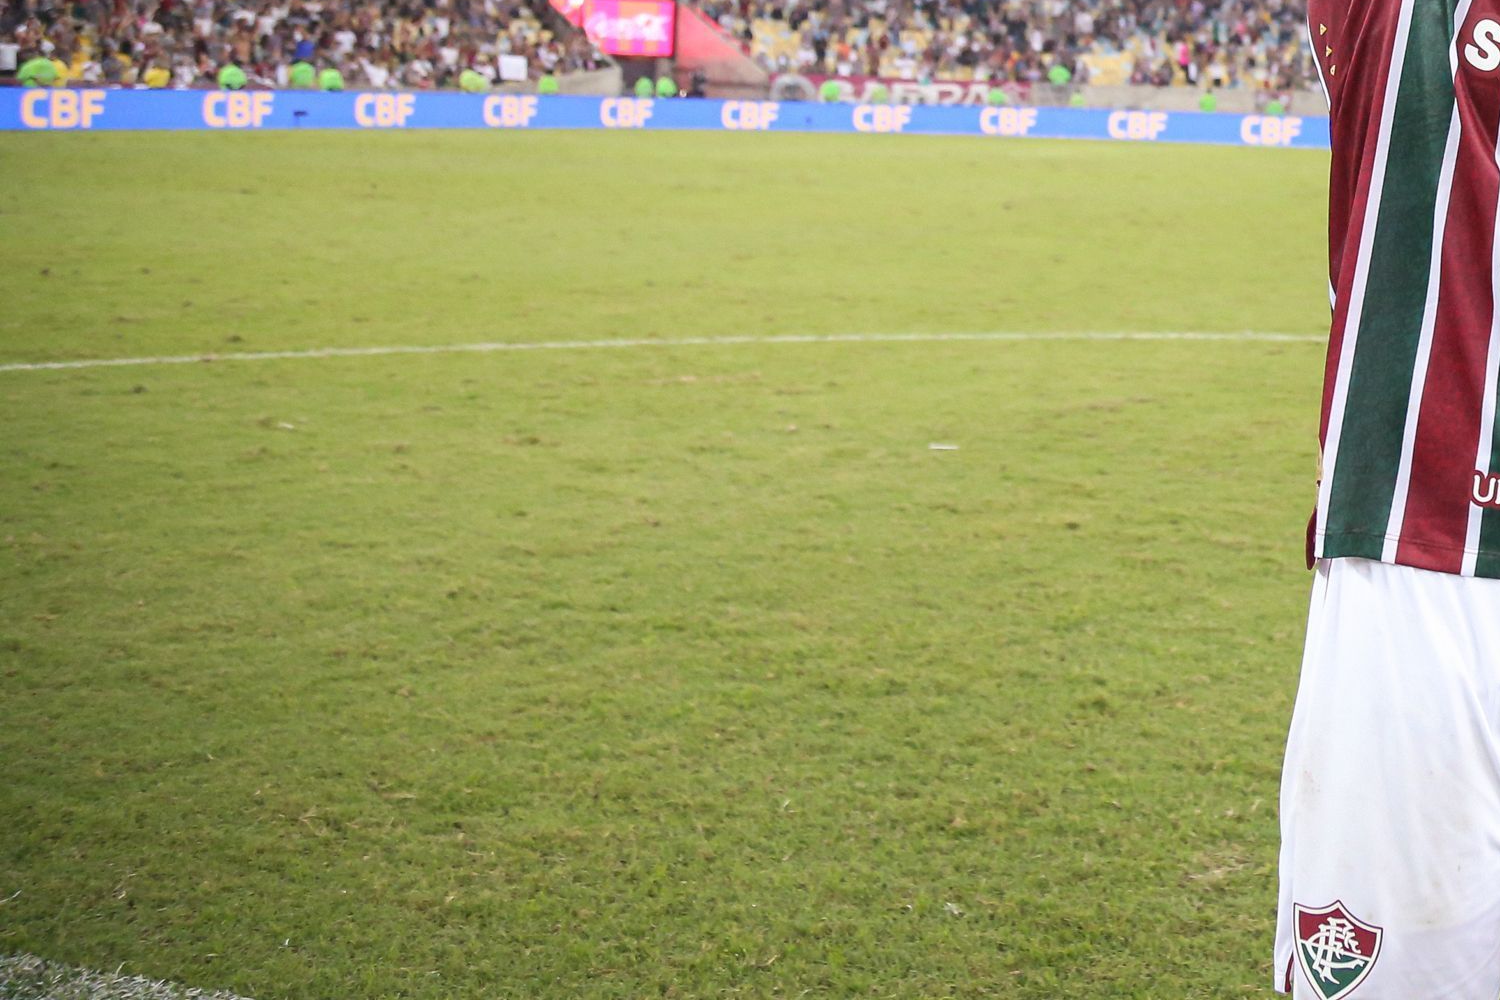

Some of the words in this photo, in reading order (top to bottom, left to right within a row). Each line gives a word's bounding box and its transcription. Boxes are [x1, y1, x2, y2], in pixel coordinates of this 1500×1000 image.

[20, 89, 106, 128] CBF
[203, 91, 274, 127] CBF
[354, 93, 415, 127] CBF
[483, 95, 538, 127] CBF
[600, 98, 654, 127] CBF
[722, 101, 779, 130] CBF
[853, 104, 912, 132] CBF
[980, 107, 1038, 135] CBF
[1107, 111, 1167, 140] CBF
[1240, 115, 1302, 145] CBF
